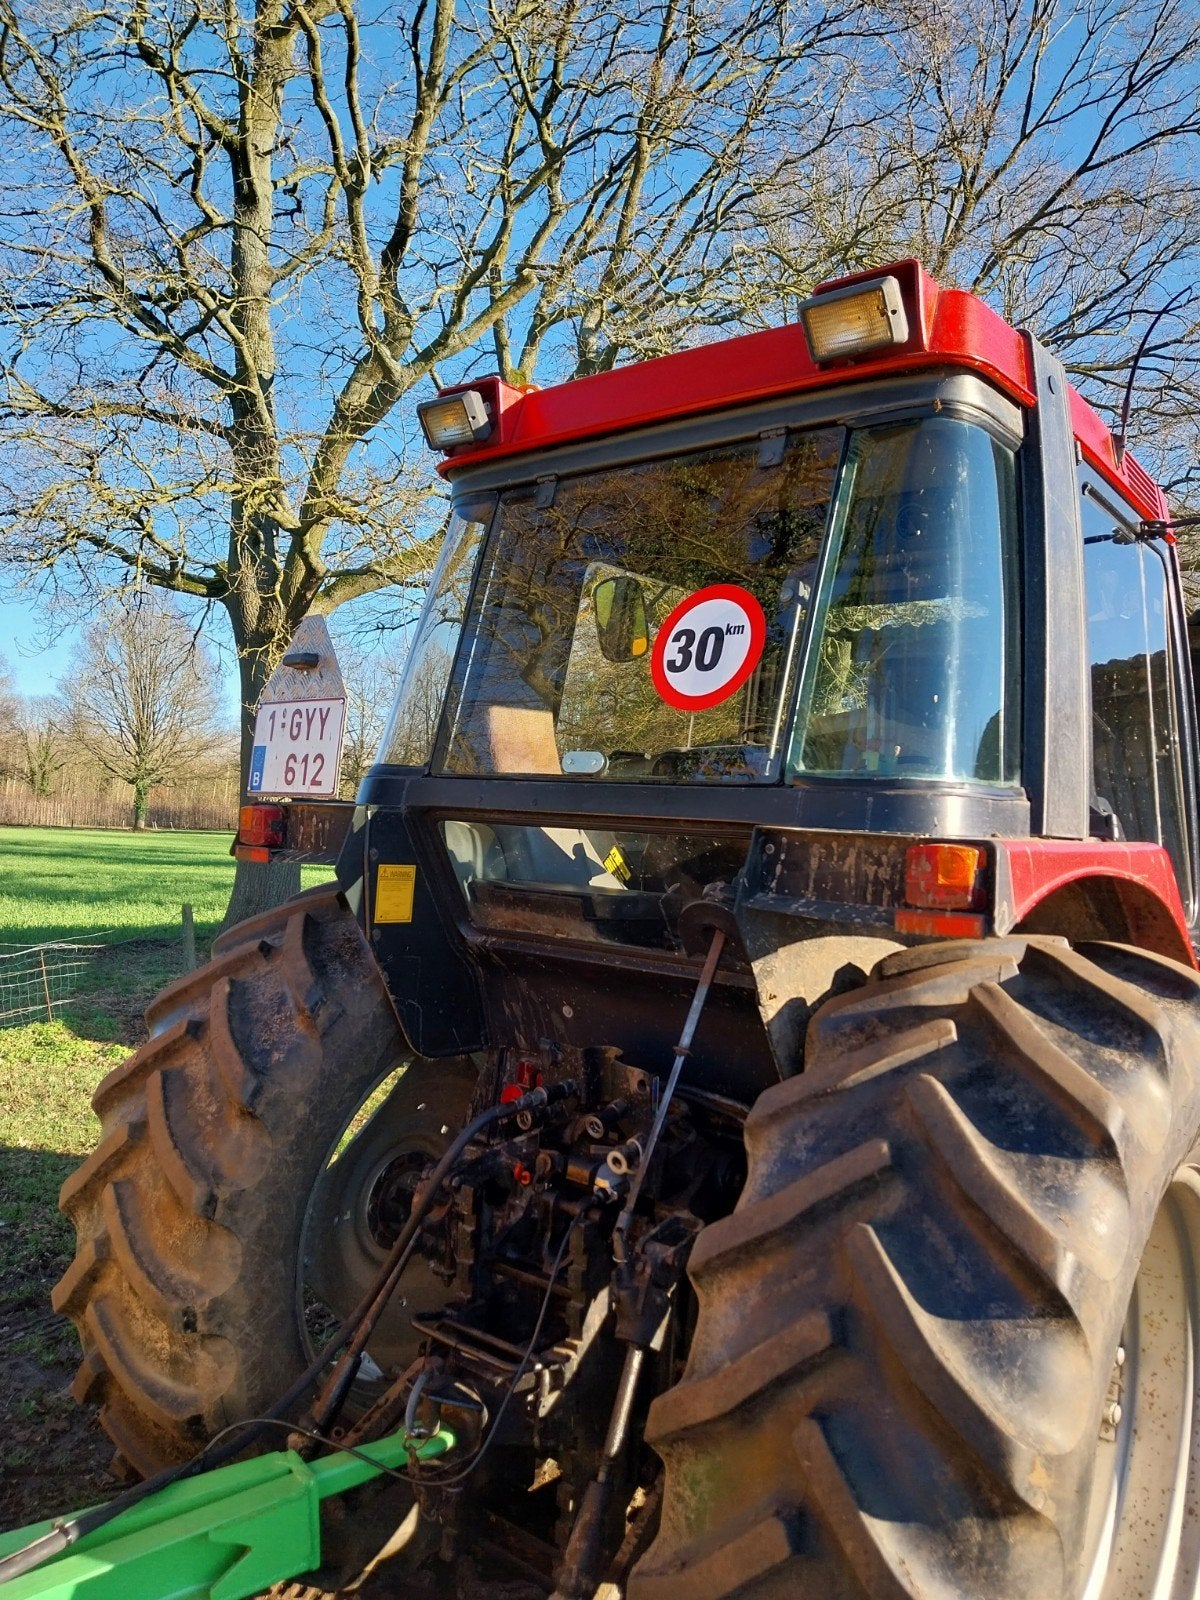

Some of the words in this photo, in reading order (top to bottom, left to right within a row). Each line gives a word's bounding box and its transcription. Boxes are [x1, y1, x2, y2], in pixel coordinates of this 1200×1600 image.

[666, 626, 725, 673] 30
[725, 623, 745, 636] km
[252, 771, 260, 786] B
[284, 752, 325, 786] 612
